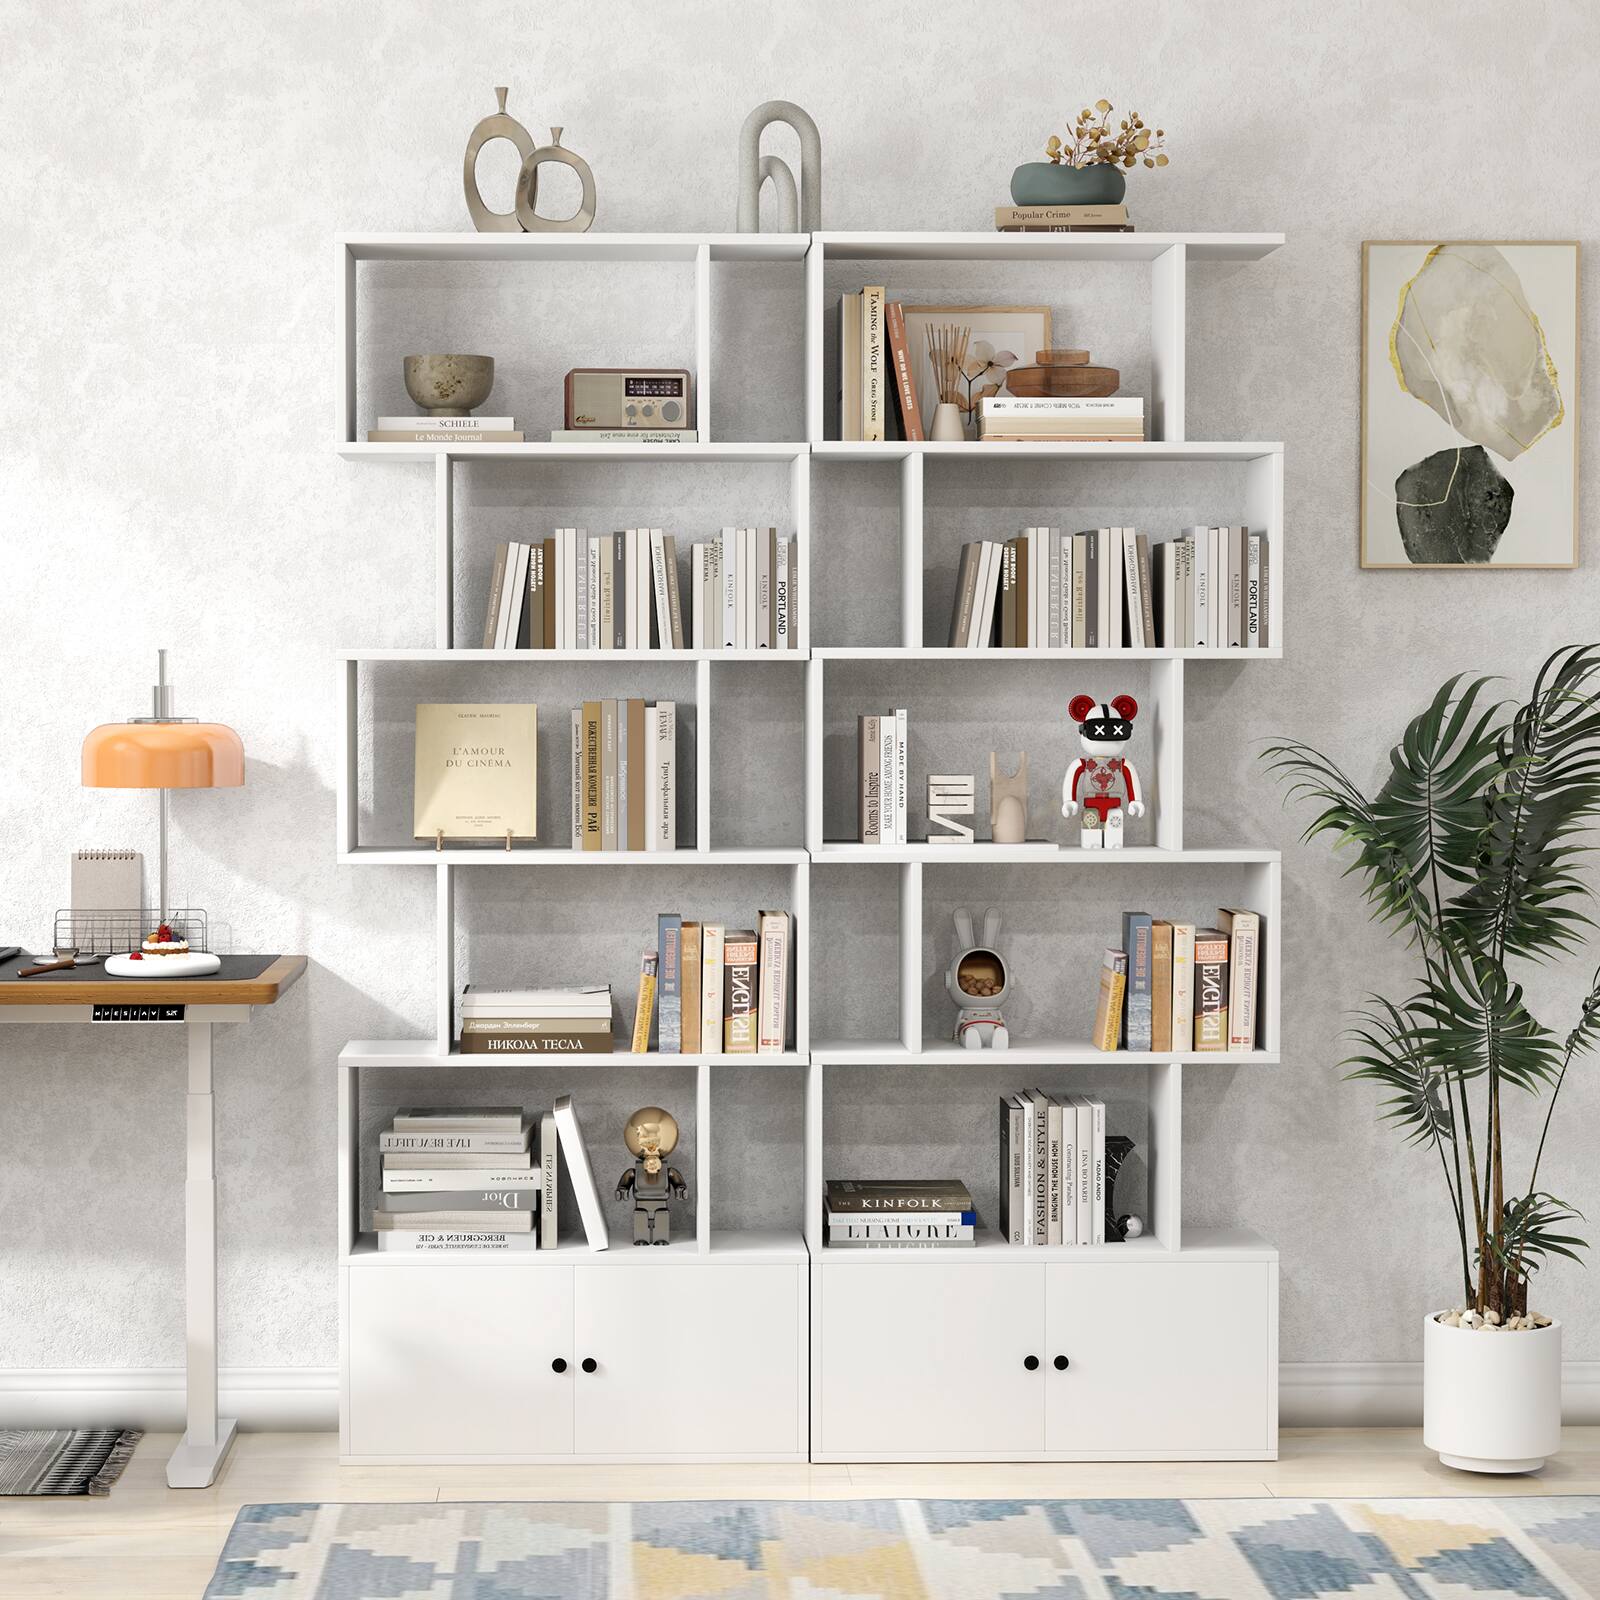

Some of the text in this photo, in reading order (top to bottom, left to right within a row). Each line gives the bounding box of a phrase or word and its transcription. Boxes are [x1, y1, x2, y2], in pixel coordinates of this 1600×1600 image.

[1012, 210, 1070, 220] Popular Crime
[870, 292, 880, 422] TAMING the WOLF GREG STONE
[900, 363, 906, 372] DO
[900, 372, 908, 381] WE
[902, 382, 910, 396] LOVE
[905, 396, 914, 410] CATS
[438, 420, 480, 428] SCHIELE
[453, 434, 482, 442] Journal
[778, 581, 786, 635] PORTLAND
[1249, 580, 1258, 634] PORTLAND
[453, 748, 505, 756] L'AMOUR
[446, 758, 511, 768] DU CINÉMA
[588, 721, 599, 832] БОЖЕСТВЕННАЯ КОМЕДИЯ РАЙ
[899, 770, 904, 780] BY
[884, 735, 892, 830] MAKE YOUR HOME AMONG FRIENDS
[660, 761, 670, 840] Триумфальная арка
[865, 772, 880, 836] Rooms to Inspire
[488, 1040, 583, 1050] НИКОЛА ТЕСЛА
[1065, 1143, 1073, 1180] Constructing
[1036, 1111, 1045, 1235] FASHION & STYLE
[1082, 1168, 1088, 1179] BO
[482, 1192, 518, 1208] Dior
[862, 1200, 942, 1208] KINFOLK
